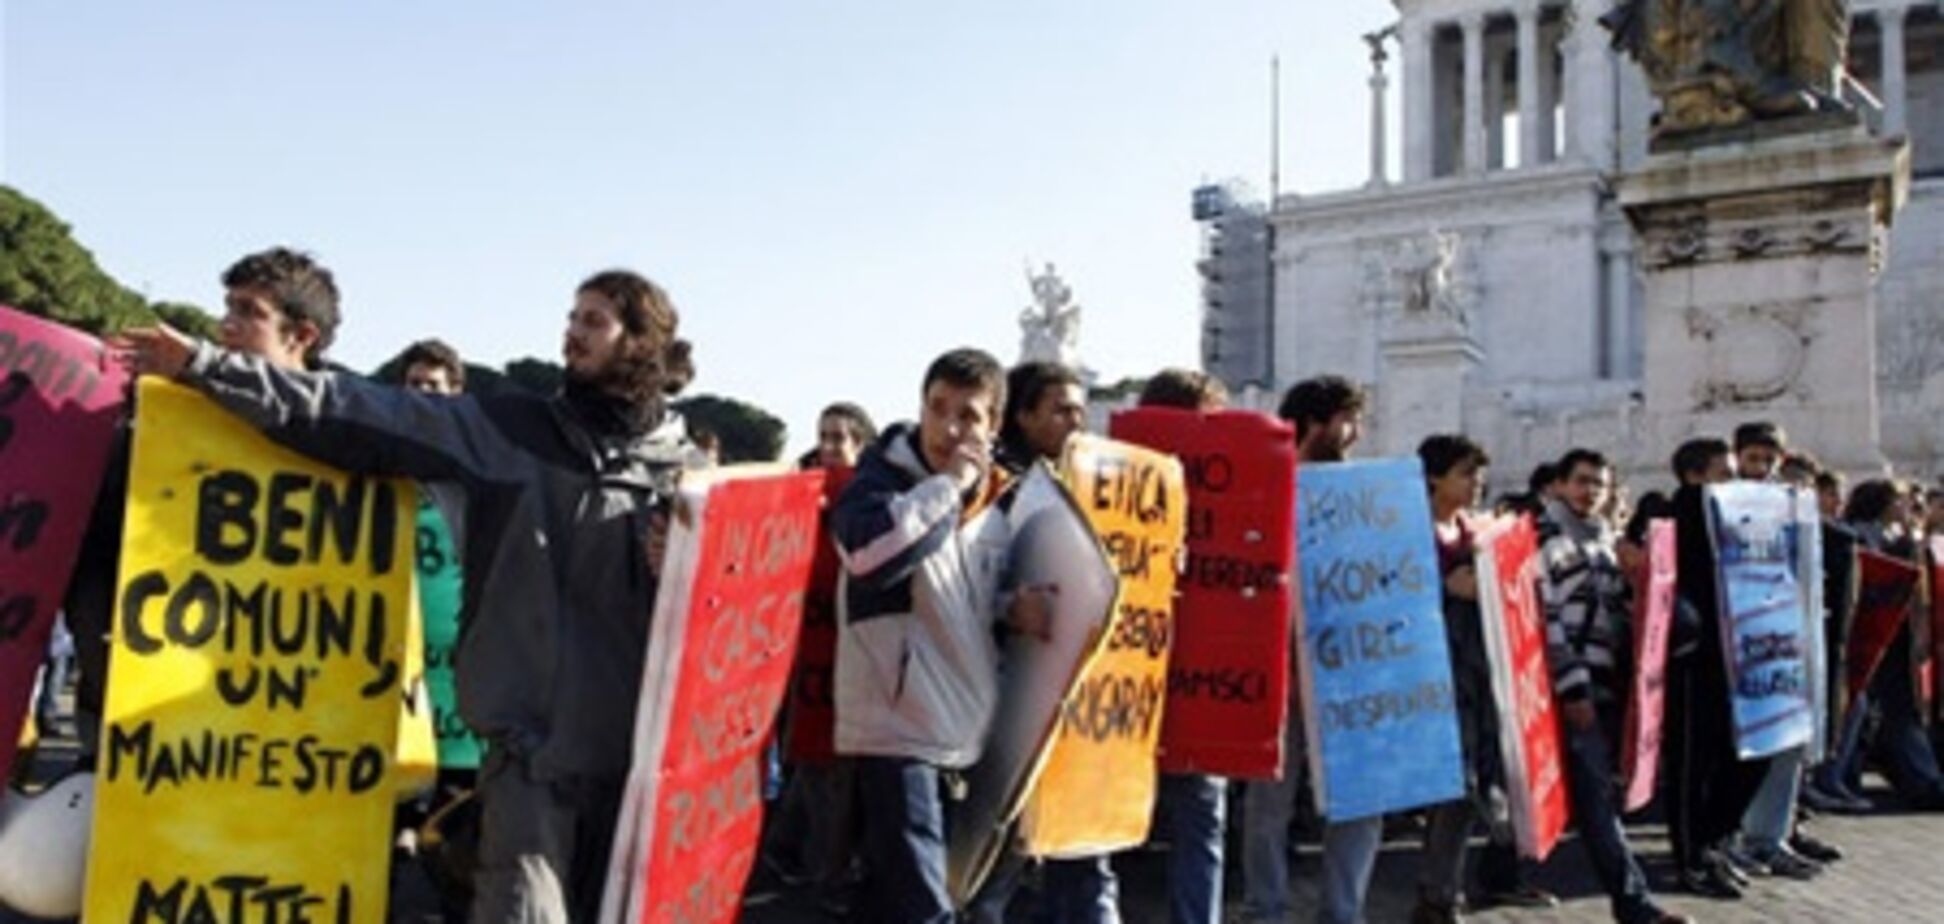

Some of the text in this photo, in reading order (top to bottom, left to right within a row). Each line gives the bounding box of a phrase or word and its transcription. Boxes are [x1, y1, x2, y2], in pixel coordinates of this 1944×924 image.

[196, 471, 398, 574] BENI
[1093, 460, 1168, 525] ETICA
[1303, 486, 1399, 532] KING
[107, 720, 384, 794] MANIFESTO
